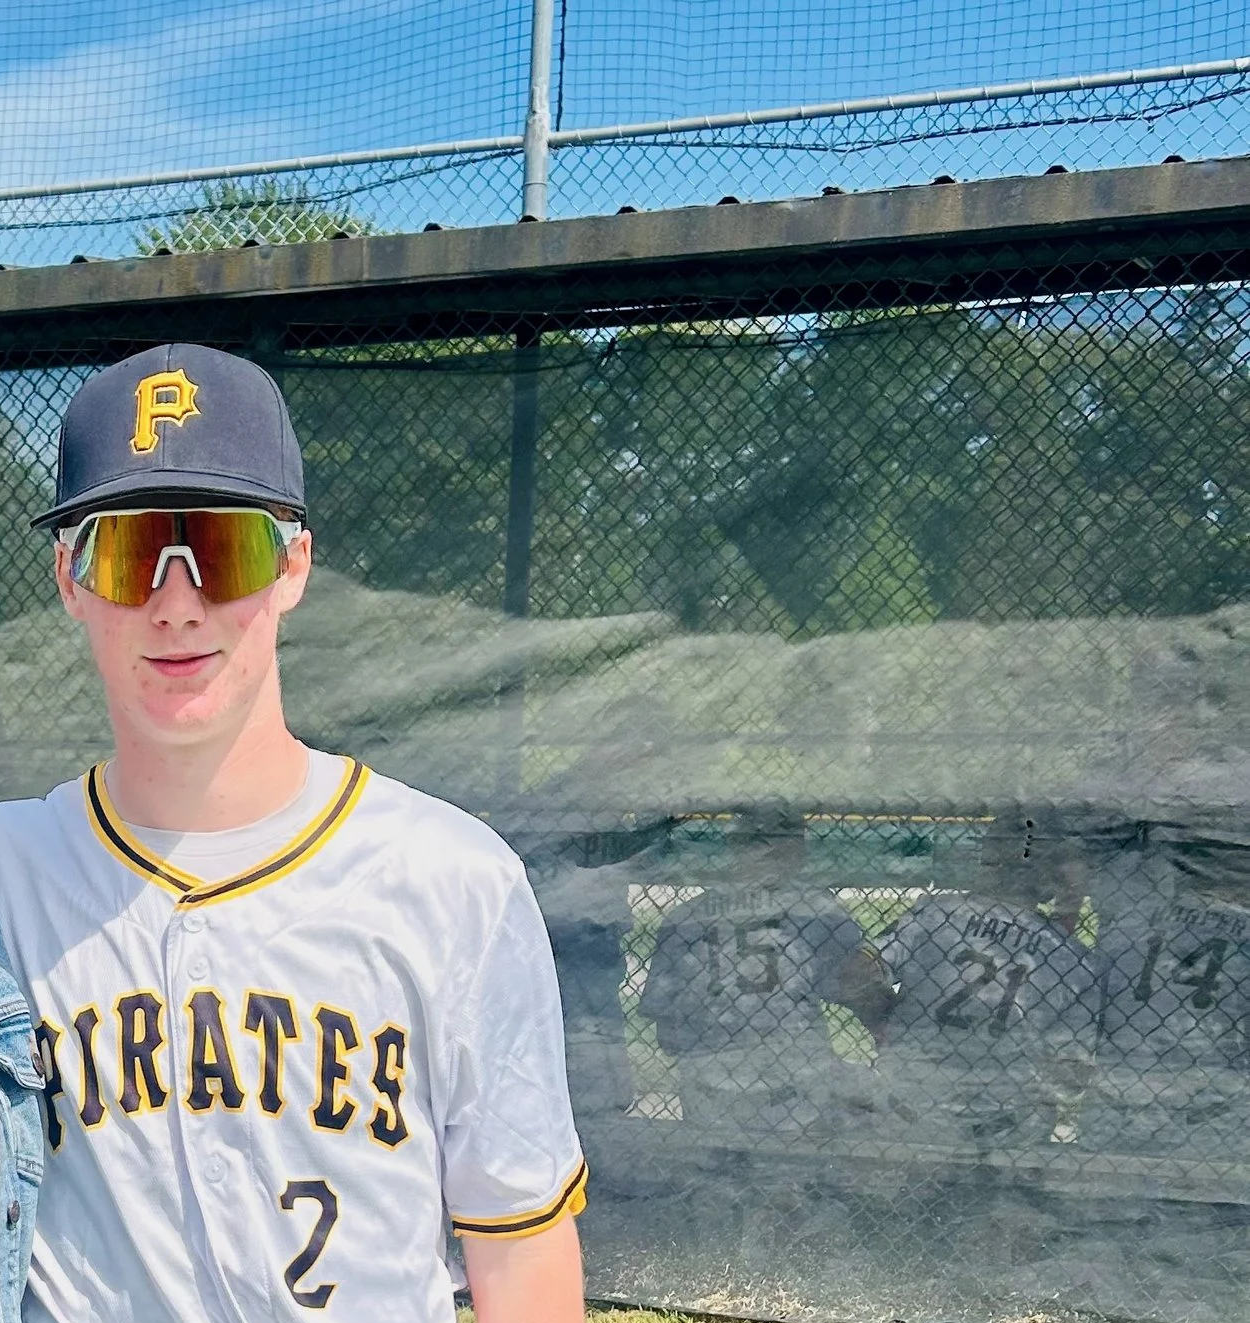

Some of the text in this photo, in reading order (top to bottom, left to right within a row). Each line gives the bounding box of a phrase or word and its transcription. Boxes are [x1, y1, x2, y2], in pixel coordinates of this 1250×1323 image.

[130, 368, 201, 454] P
[935, 948, 1027, 1038] 21
[1133, 932, 1229, 1010] 14
[35, 989, 413, 1153] PIRATES
[279, 1179, 340, 1309] 2
